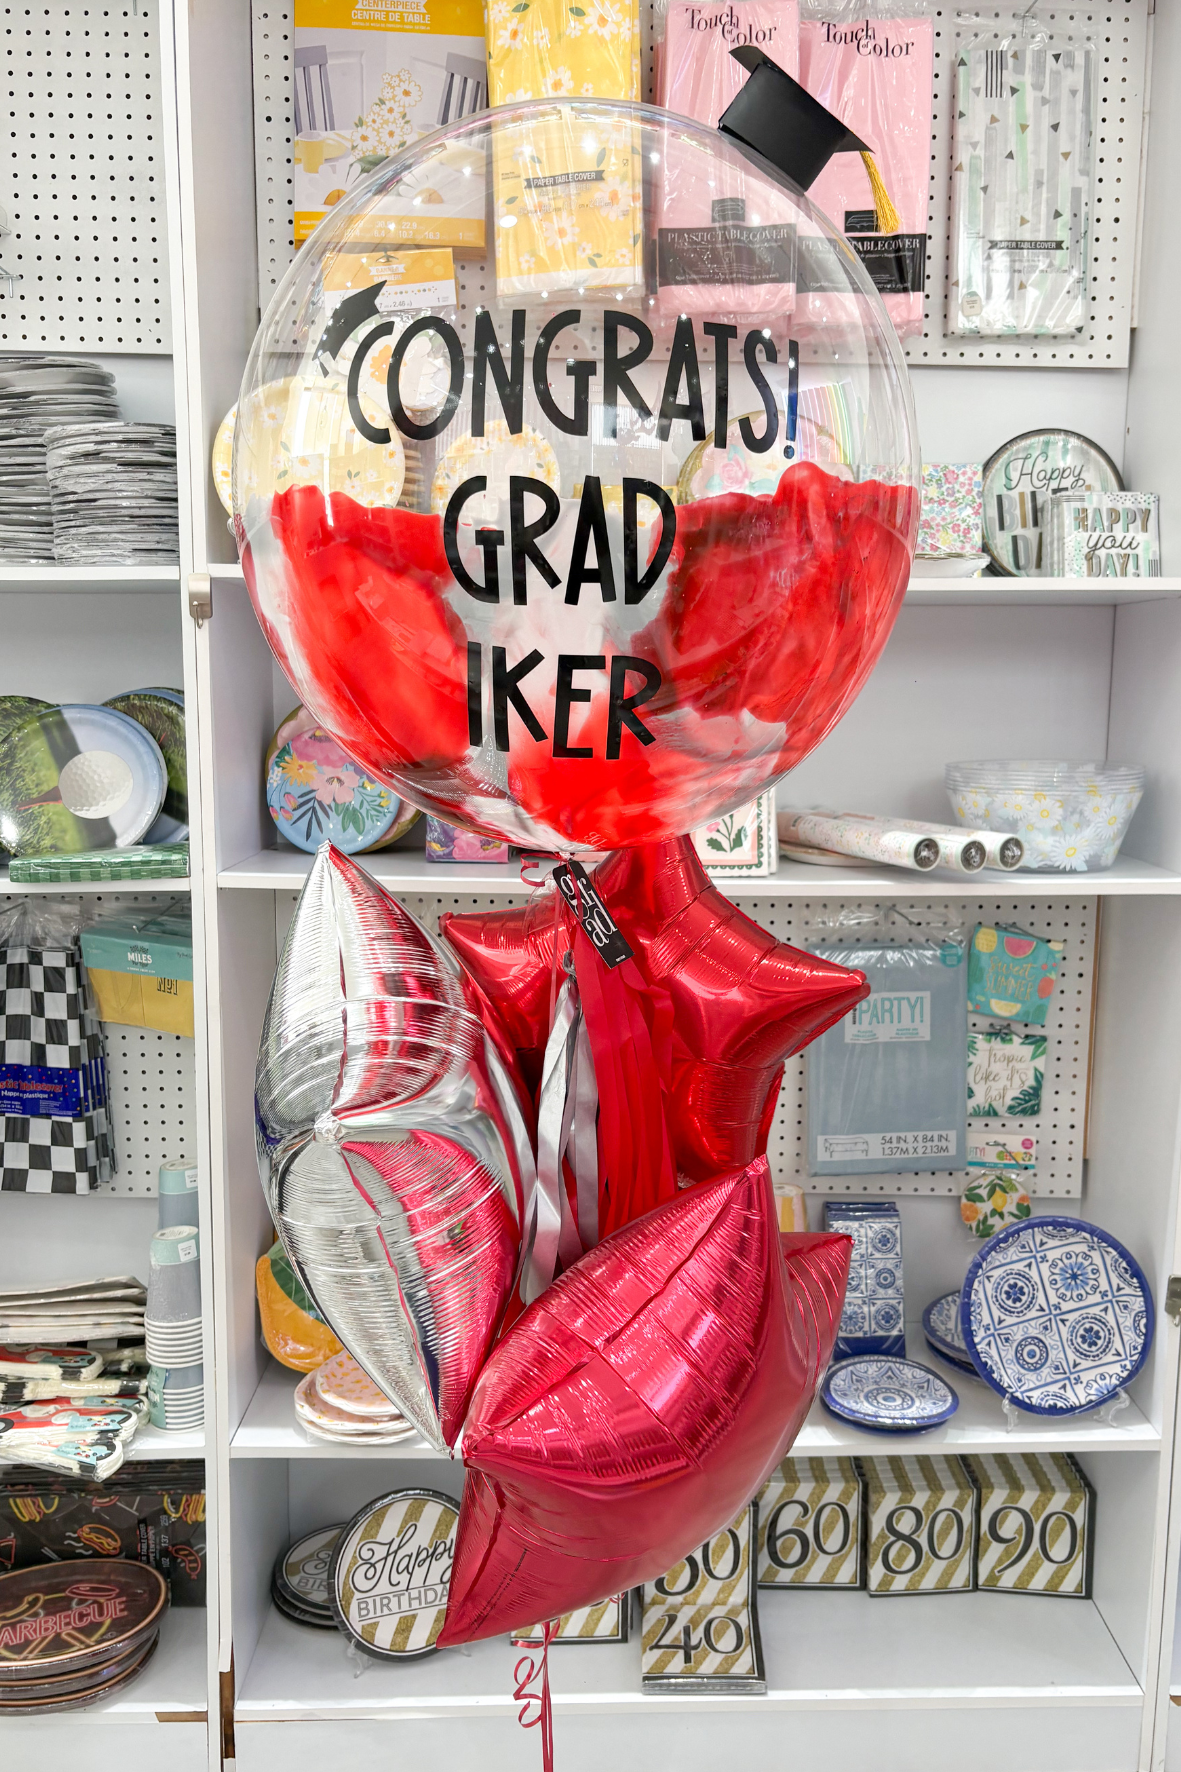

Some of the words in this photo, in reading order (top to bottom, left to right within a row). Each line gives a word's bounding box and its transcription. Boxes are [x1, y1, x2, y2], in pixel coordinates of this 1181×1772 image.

[352, 10, 386, 21] CENTRE
[389, 12, 400, 22] DE
[403, 13, 430, 23] TABLE
[361, 0, 421, 10] CENTERPIECE
[684, 5, 740, 32] Touch
[722, 20, 777, 45] Color
[822, 20, 876, 45] Touch
[856, 34, 914, 58] Color
[534, 177, 554, 186] PAPER
[554, 174, 574, 184] TABLE
[574, 172, 596, 181] COVER
[668, 230, 716, 242] PLASTIC
[716, 228, 788, 242] TABLECOVER
[347, 309, 798, 459] CONGRATS!
[1004, 452, 1086, 492] Happy
[1073, 508, 1151, 533] HAPPY
[444, 475, 676, 606] GRAD
[1084, 534, 1140, 561] you
[1086, 553, 1140, 577] DAY!
[466, 641, 662, 760] IKER
[128, 952, 152, 964] MILES
[988, 956, 1038, 980] Sweet
[984, 974, 1033, 1000] SUMMER
[858, 996, 924, 1026] PARTY!
[0, 1079, 18, 1089] stic
[974, 1064, 1001, 1085] like
[880, 1136, 893, 1145] 54
[896, 1135, 909, 1144] IN.
[912, 1134, 919, 1144] X
[922, 1134, 934, 1143] 84
[938, 1133, 950, 1142] IN.
[882, 1146, 909, 1156] 1.37M
[912, 1146, 919, 1155] X
[922, 1145, 949, 1155] 2.13M
[766, 1500, 851, 1570] 60
[881, 1505, 964, 1575] 80
[988, 1505, 1078, 1576] 90
[352, 1523, 454, 1593] Happy
[357, 1586, 449, 1618] BIRTHDA
[0, 1596, 128, 1647] ARBECUE
[649, 1614, 744, 1664] 40
